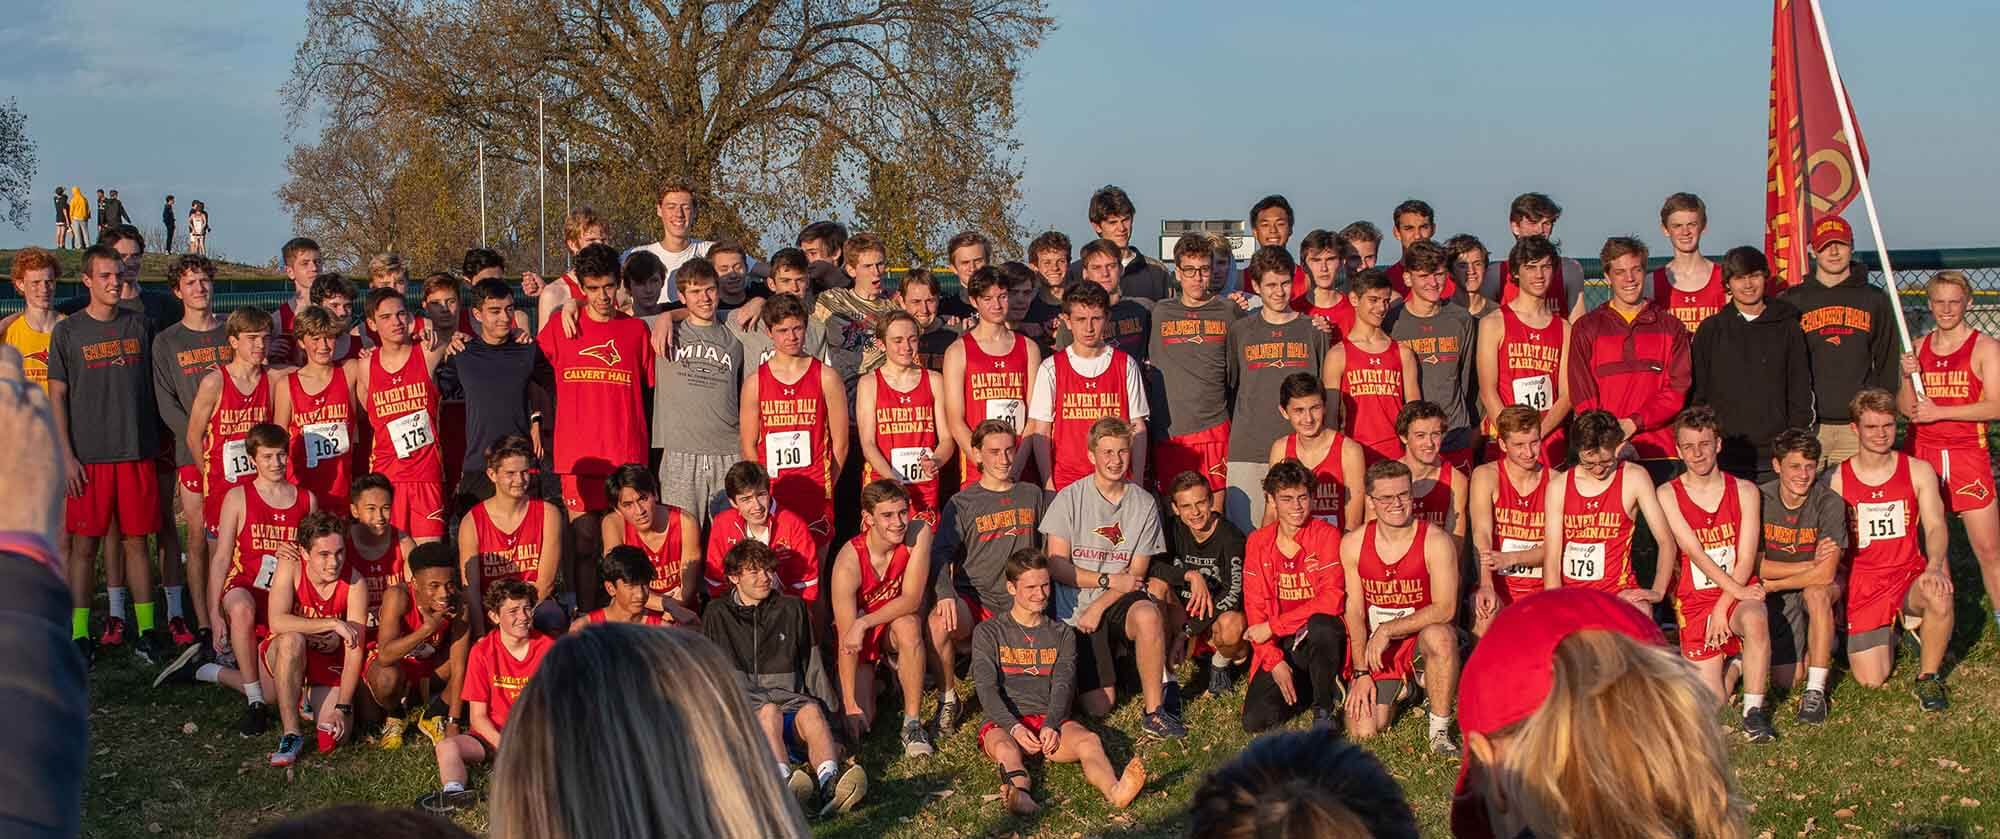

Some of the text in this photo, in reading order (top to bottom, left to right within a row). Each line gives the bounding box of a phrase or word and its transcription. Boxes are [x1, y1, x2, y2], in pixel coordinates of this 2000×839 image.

[675, 345, 732, 371] MIAA
[1508, 343, 1541, 359] CALVERT
[564, 370, 632, 383] CALVERT HALL
[971, 373, 1007, 388] CALVERT
[1347, 368, 1382, 385] CALVERT
[1948, 371, 1969, 385] HALL
[372, 385, 406, 406] CALVERT
[1063, 392, 1120, 407] CALVERT HALL
[1525, 391, 1546, 409] 143
[1926, 386, 1969, 398] RDINALS
[761, 400, 795, 415] CALVERT
[1062, 407, 1121, 419] CARDINALS
[294, 408, 326, 427] CALVERT
[763, 413, 817, 427] CARDINALS
[877, 408, 913, 424] CALVERT
[401, 427, 428, 450] 175
[314, 438, 340, 457] 162
[1496, 507, 1529, 527] CALVERT
[1599, 512, 1621, 527] HALL
[251, 524, 286, 540] CALVERT
[1869, 518, 1896, 537] 151
[517, 544, 539, 563] HALL
[1570, 559, 1595, 577] 179
[1400, 578, 1423, 593] HALL
